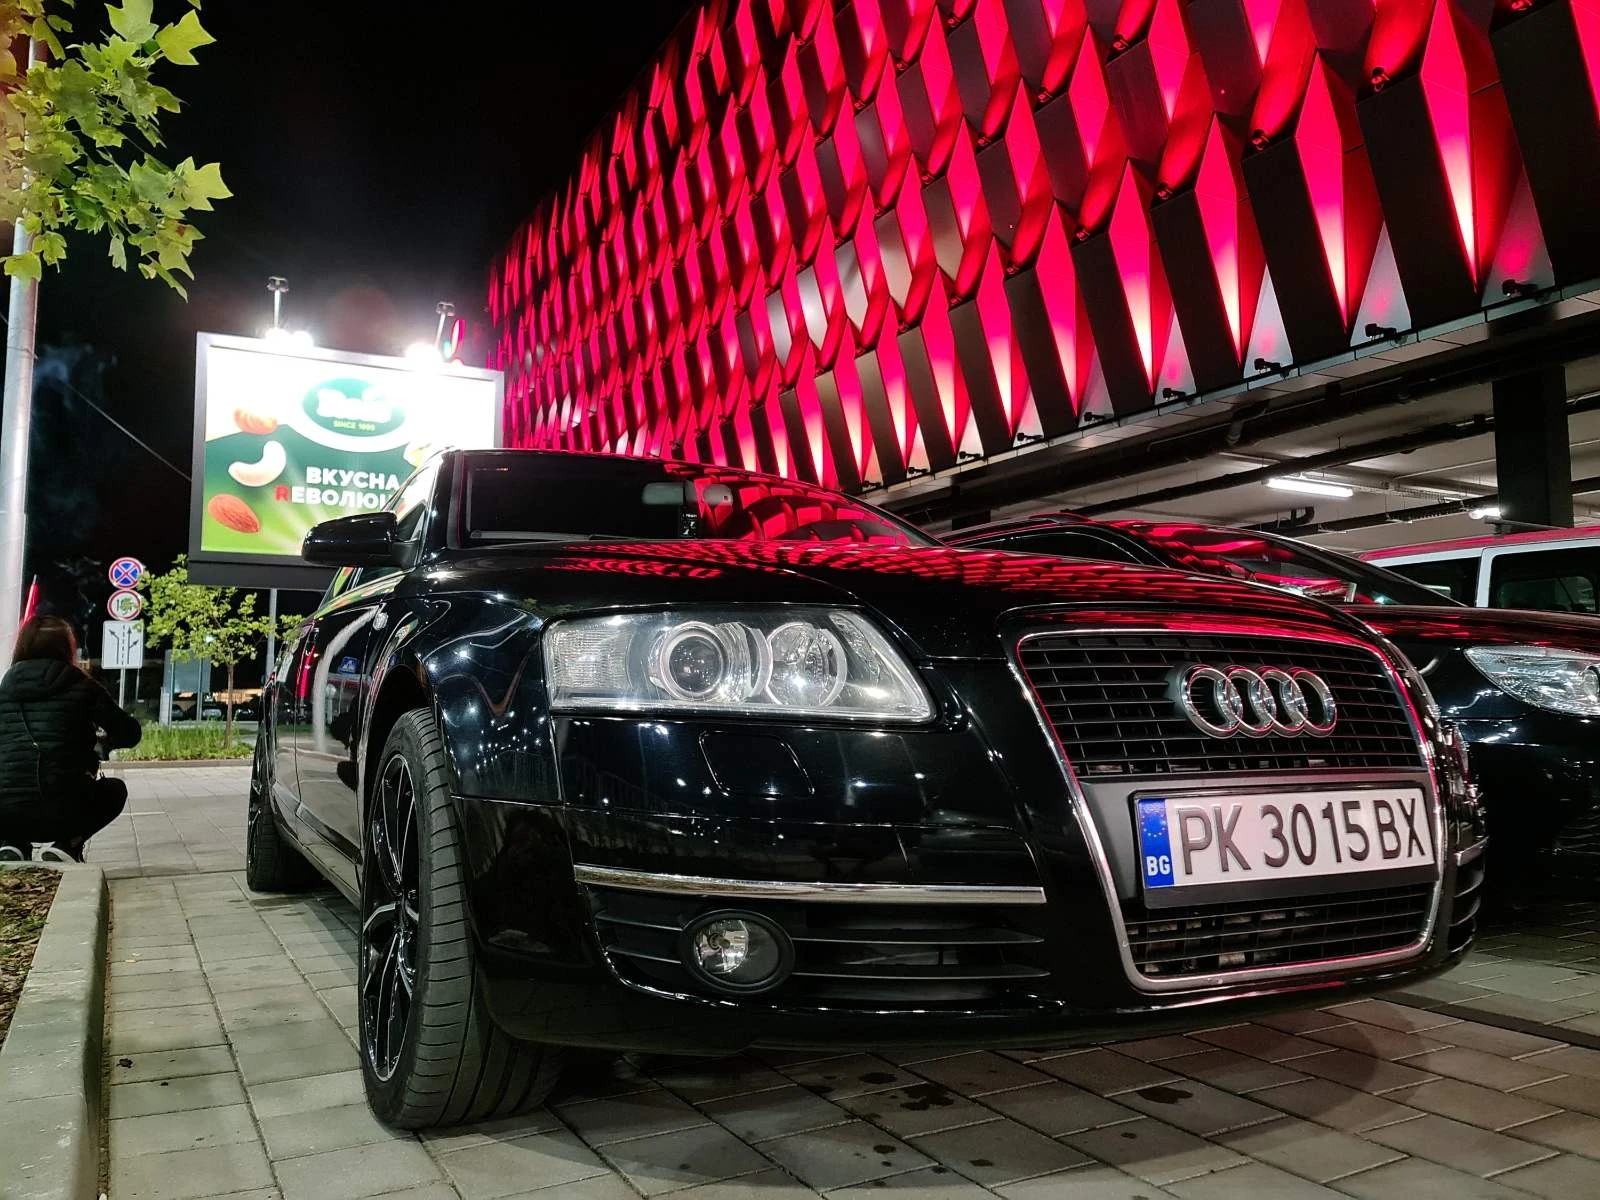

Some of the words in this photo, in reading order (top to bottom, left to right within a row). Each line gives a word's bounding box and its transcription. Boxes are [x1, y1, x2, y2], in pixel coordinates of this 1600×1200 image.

[333, 420, 357, 429] SINCE
[306, 466, 400, 491] ВКУСНА
[1177, 805, 1252, 875] PK
[1260, 800, 1371, 868] 3015
[1373, 798, 1426, 860] BX
[1146, 855, 1171, 877] BG
